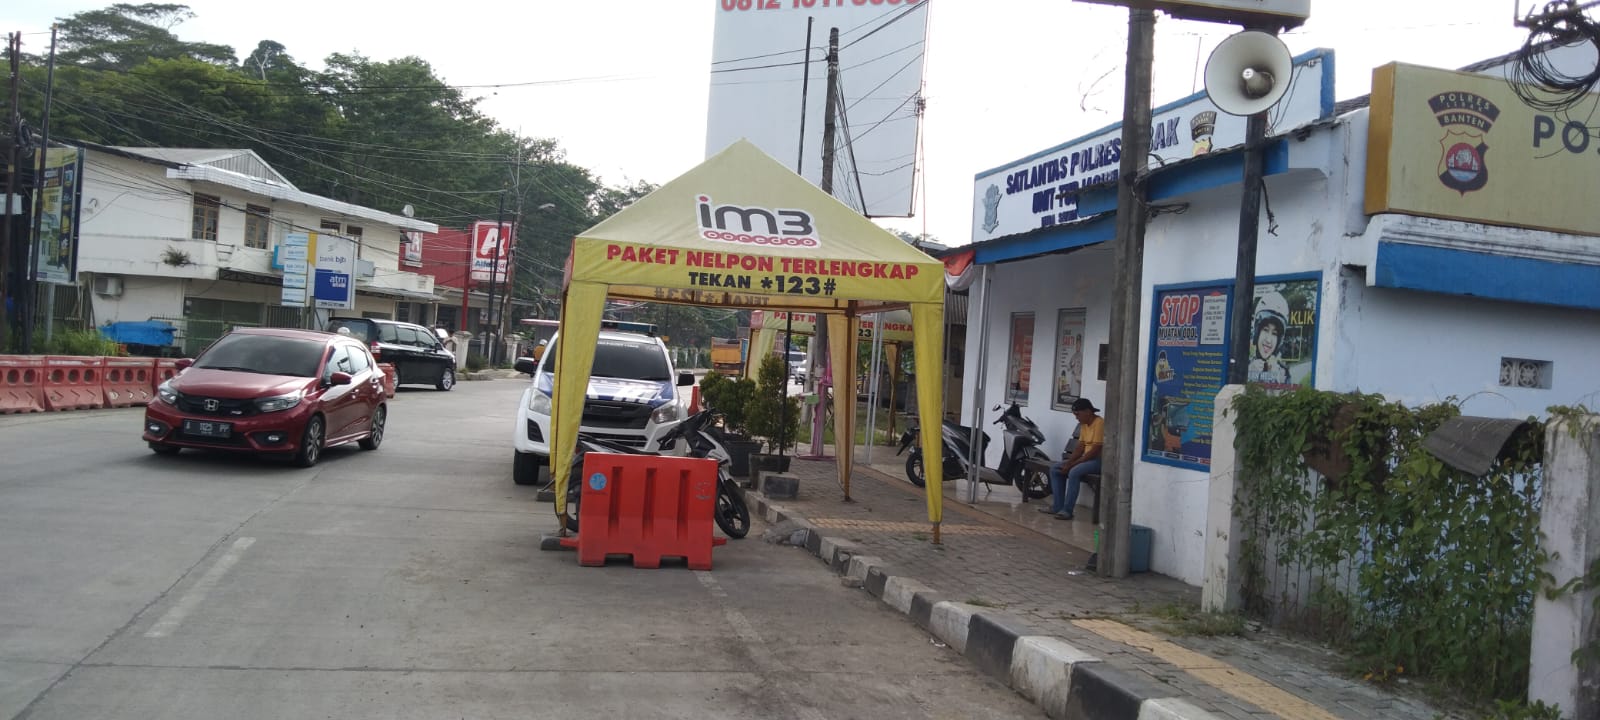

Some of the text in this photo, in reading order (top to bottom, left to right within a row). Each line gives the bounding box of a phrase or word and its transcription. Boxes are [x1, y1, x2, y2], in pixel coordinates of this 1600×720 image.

[1439, 93, 1490, 110] POLRES
[1443, 114, 1485, 128] BANTEN
[1533, 115, 1600, 155] PO
[1006, 155, 1068, 195] SATLANTAS
[1070, 137, 1121, 177] POLRES
[698, 195, 812, 236] im3
[703, 230, 817, 247] ooredoo
[606, 244, 919, 280] PAKET NELPON TERLENGKAP
[329, 276, 346, 284] atm
[688, 271, 751, 288] TEKAN
[1160, 295, 1200, 326] STOP
[1290, 310, 1314, 325] KLIK
[1158, 326, 1182, 338] MUATAN
